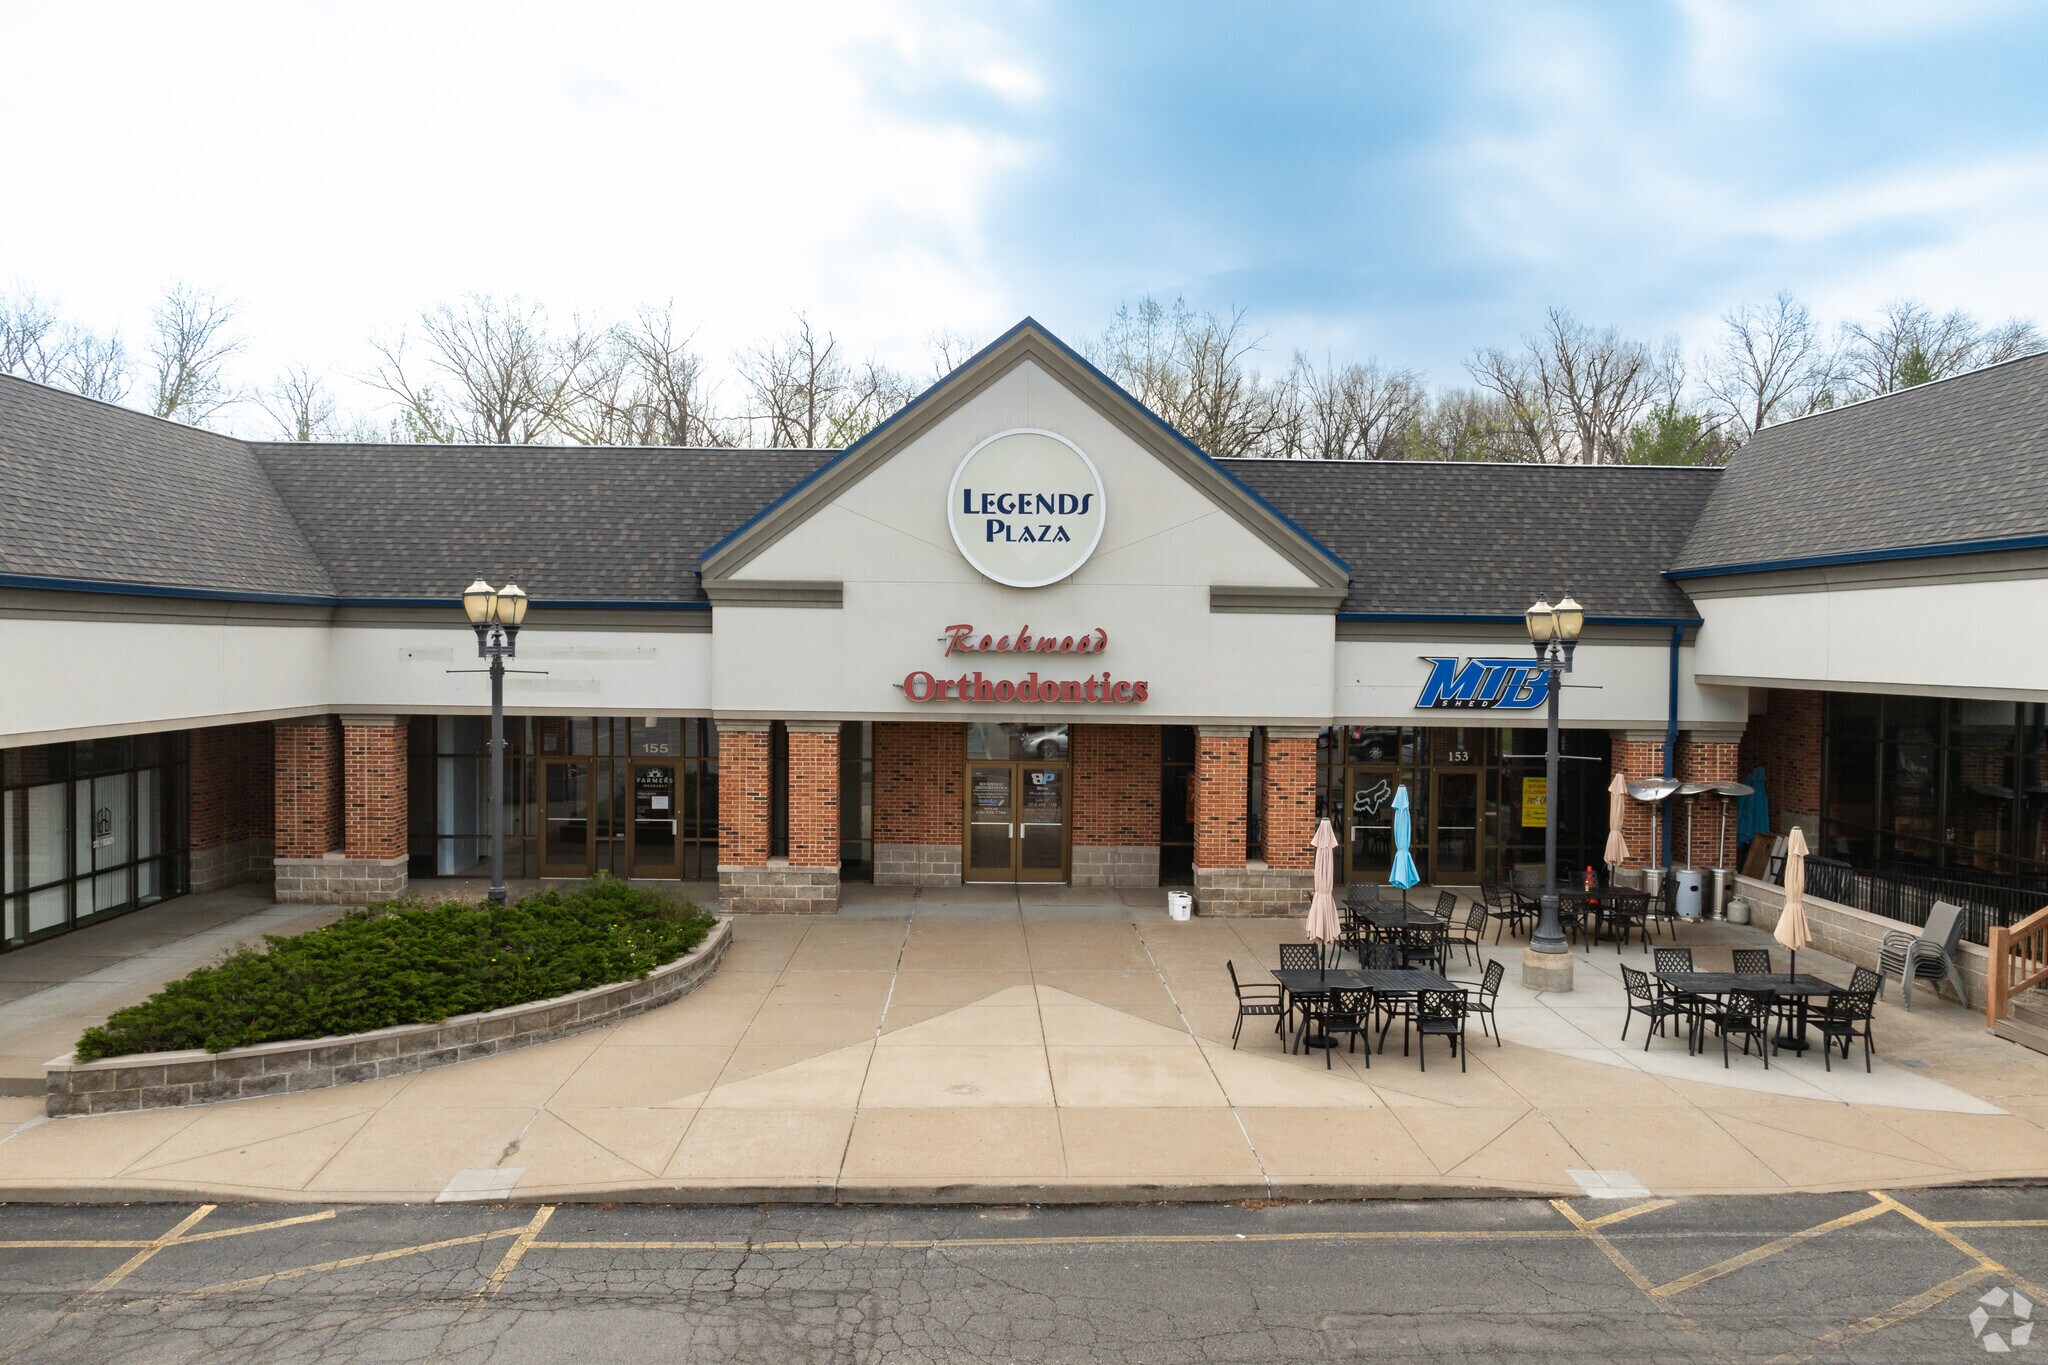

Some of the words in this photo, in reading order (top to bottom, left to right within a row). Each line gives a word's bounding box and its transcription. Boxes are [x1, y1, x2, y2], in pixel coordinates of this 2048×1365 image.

[963, 488, 1094, 515] LEGENDS
[986, 519, 1071, 543] PLAZA
[944, 624, 1108, 657] Rockwood
[903, 671, 1149, 703] Orthodontics
[1415, 657, 1559, 709] MTB
[643, 744, 669, 753] 155
[1448, 752, 1469, 762] 153
